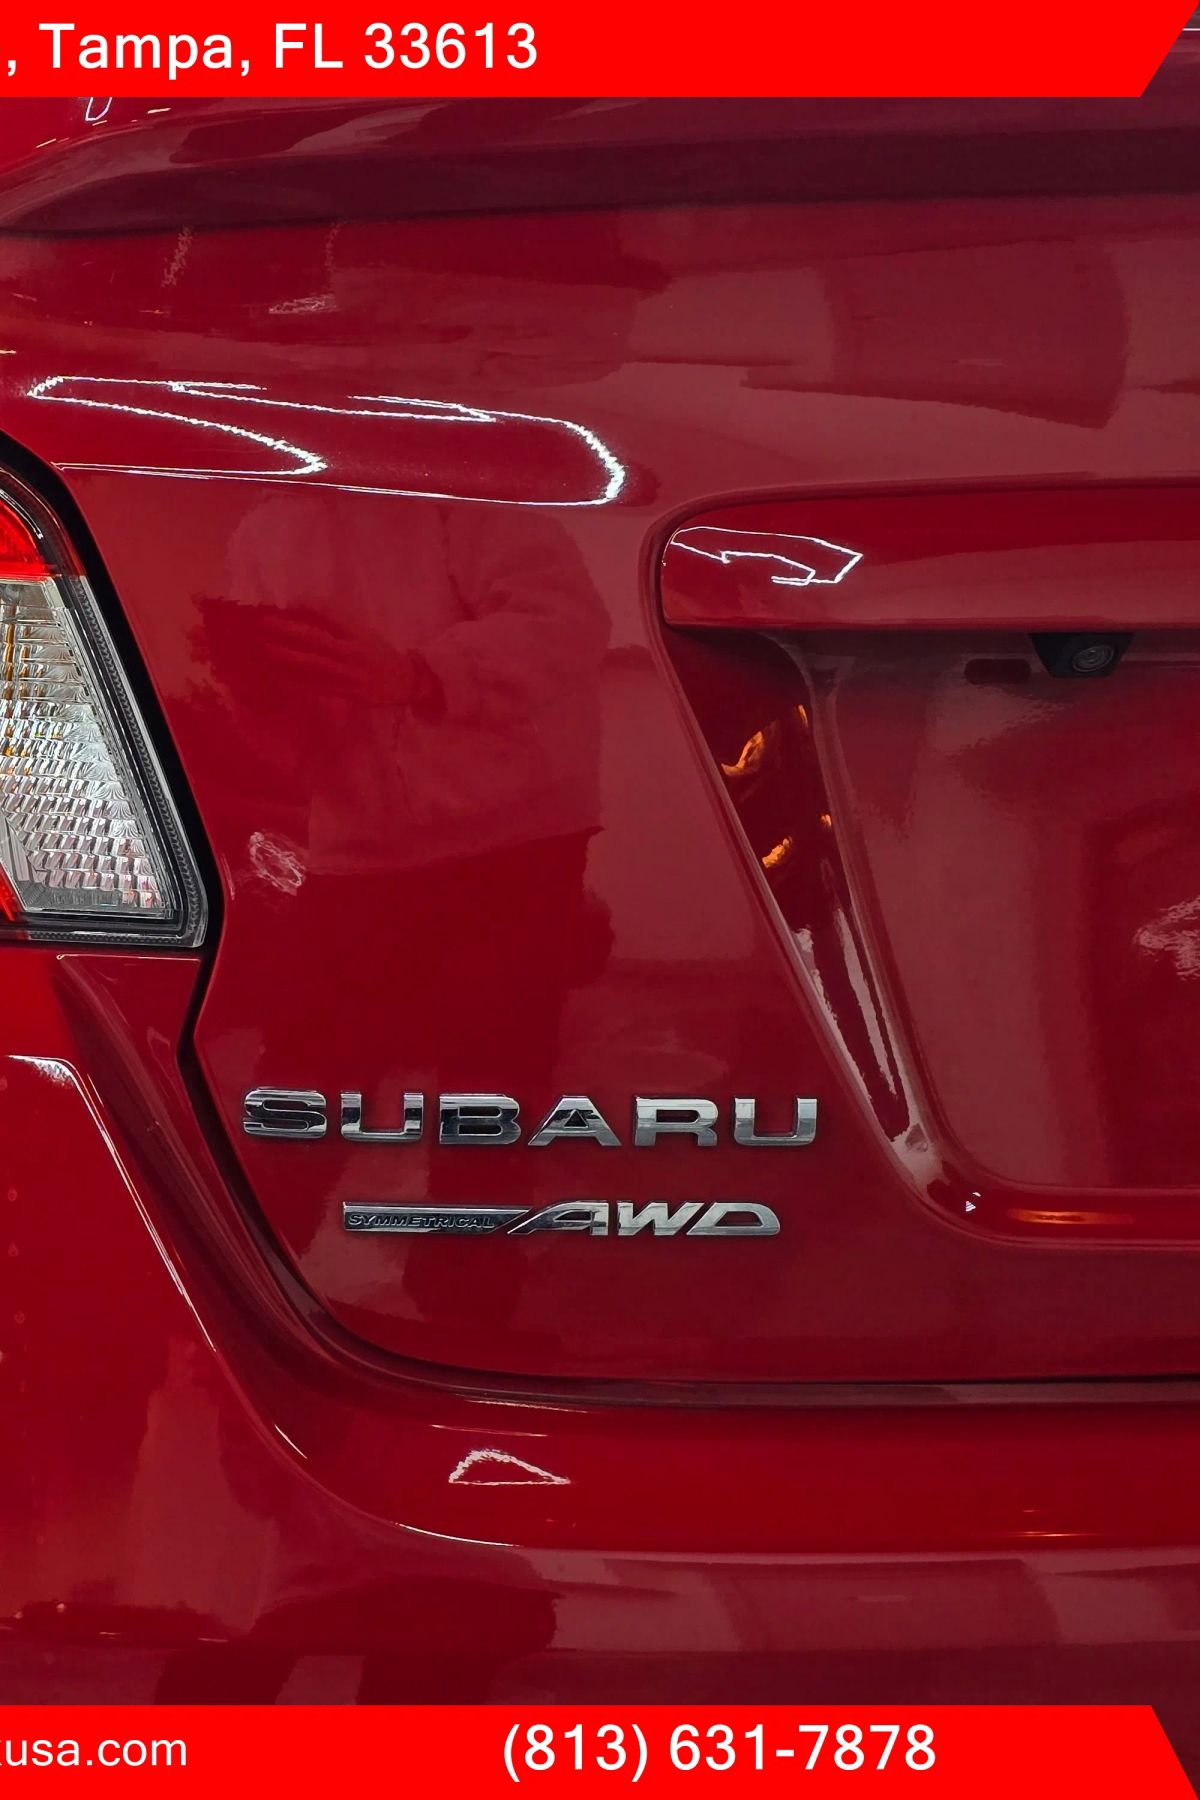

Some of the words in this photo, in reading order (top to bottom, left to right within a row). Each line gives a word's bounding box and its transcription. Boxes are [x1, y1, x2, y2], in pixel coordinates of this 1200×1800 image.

[243, 1088, 818, 1147] SUBARU
[349, 1213, 495, 1230] SYMMETRICAL
[507, 1200, 781, 1237] AWD
